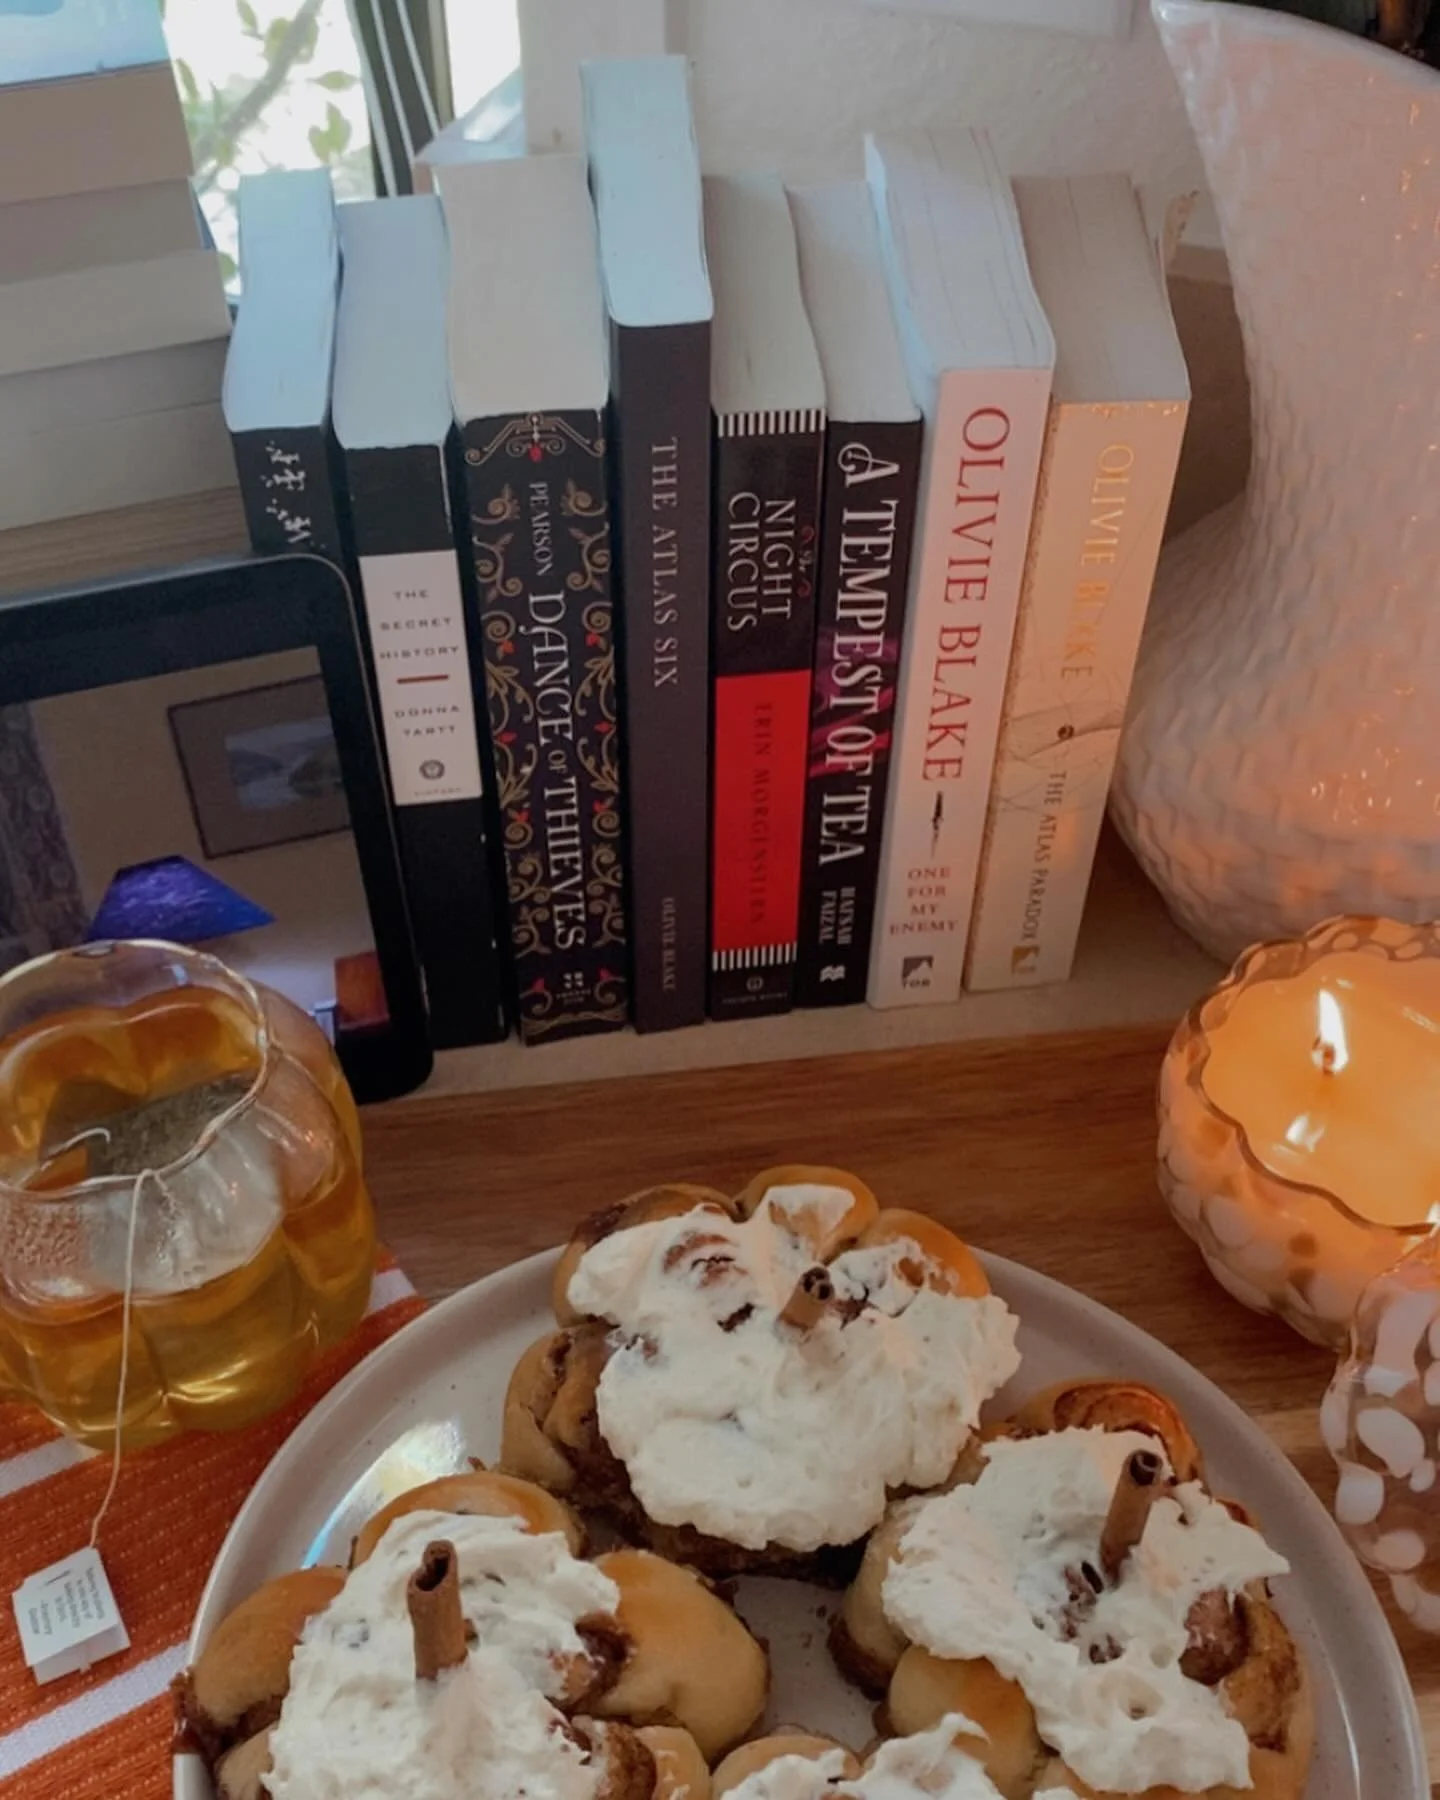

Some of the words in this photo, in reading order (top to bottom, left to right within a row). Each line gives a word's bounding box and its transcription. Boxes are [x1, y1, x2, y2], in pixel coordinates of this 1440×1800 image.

[651, 436, 678, 511] THE
[837, 442, 900, 488] A
[528, 481, 554, 576] PEARSON
[943, 407, 1011, 605] OLIVIE
[1080, 443, 1135, 566] OLIVIE
[651, 525, 679, 625] ATLAS
[727, 491, 761, 631] CIRCUS
[761, 499, 797, 620] NIGHT
[380, 616, 453, 631] SECRET
[829, 500, 899, 714] TEMPEST
[379, 645, 460, 660] HISTORY
[518, 590, 574, 746] DANCE
[653, 636, 678, 688] SIX
[394, 704, 462, 719] DONNA
[753, 702, 773, 755] ERIN
[922, 623, 982, 781] BLAKE
[403, 725, 457, 738] TARTT
[826, 725, 877, 776] OF
[548, 750, 569, 773] OF
[1043, 770, 1067, 806] THE
[819, 785, 872, 866] TEA
[1034, 813, 1058, 864] ATLAS
[543, 775, 587, 950] THIEVES
[908, 867, 951, 880] ONE
[818, 889, 837, 945] FAIZAL
[907, 884, 946, 898] FOR
[911, 902, 939, 915] MY
[1020, 867, 1050, 941] PARADOX
[890, 920, 958, 935] ENEMY
